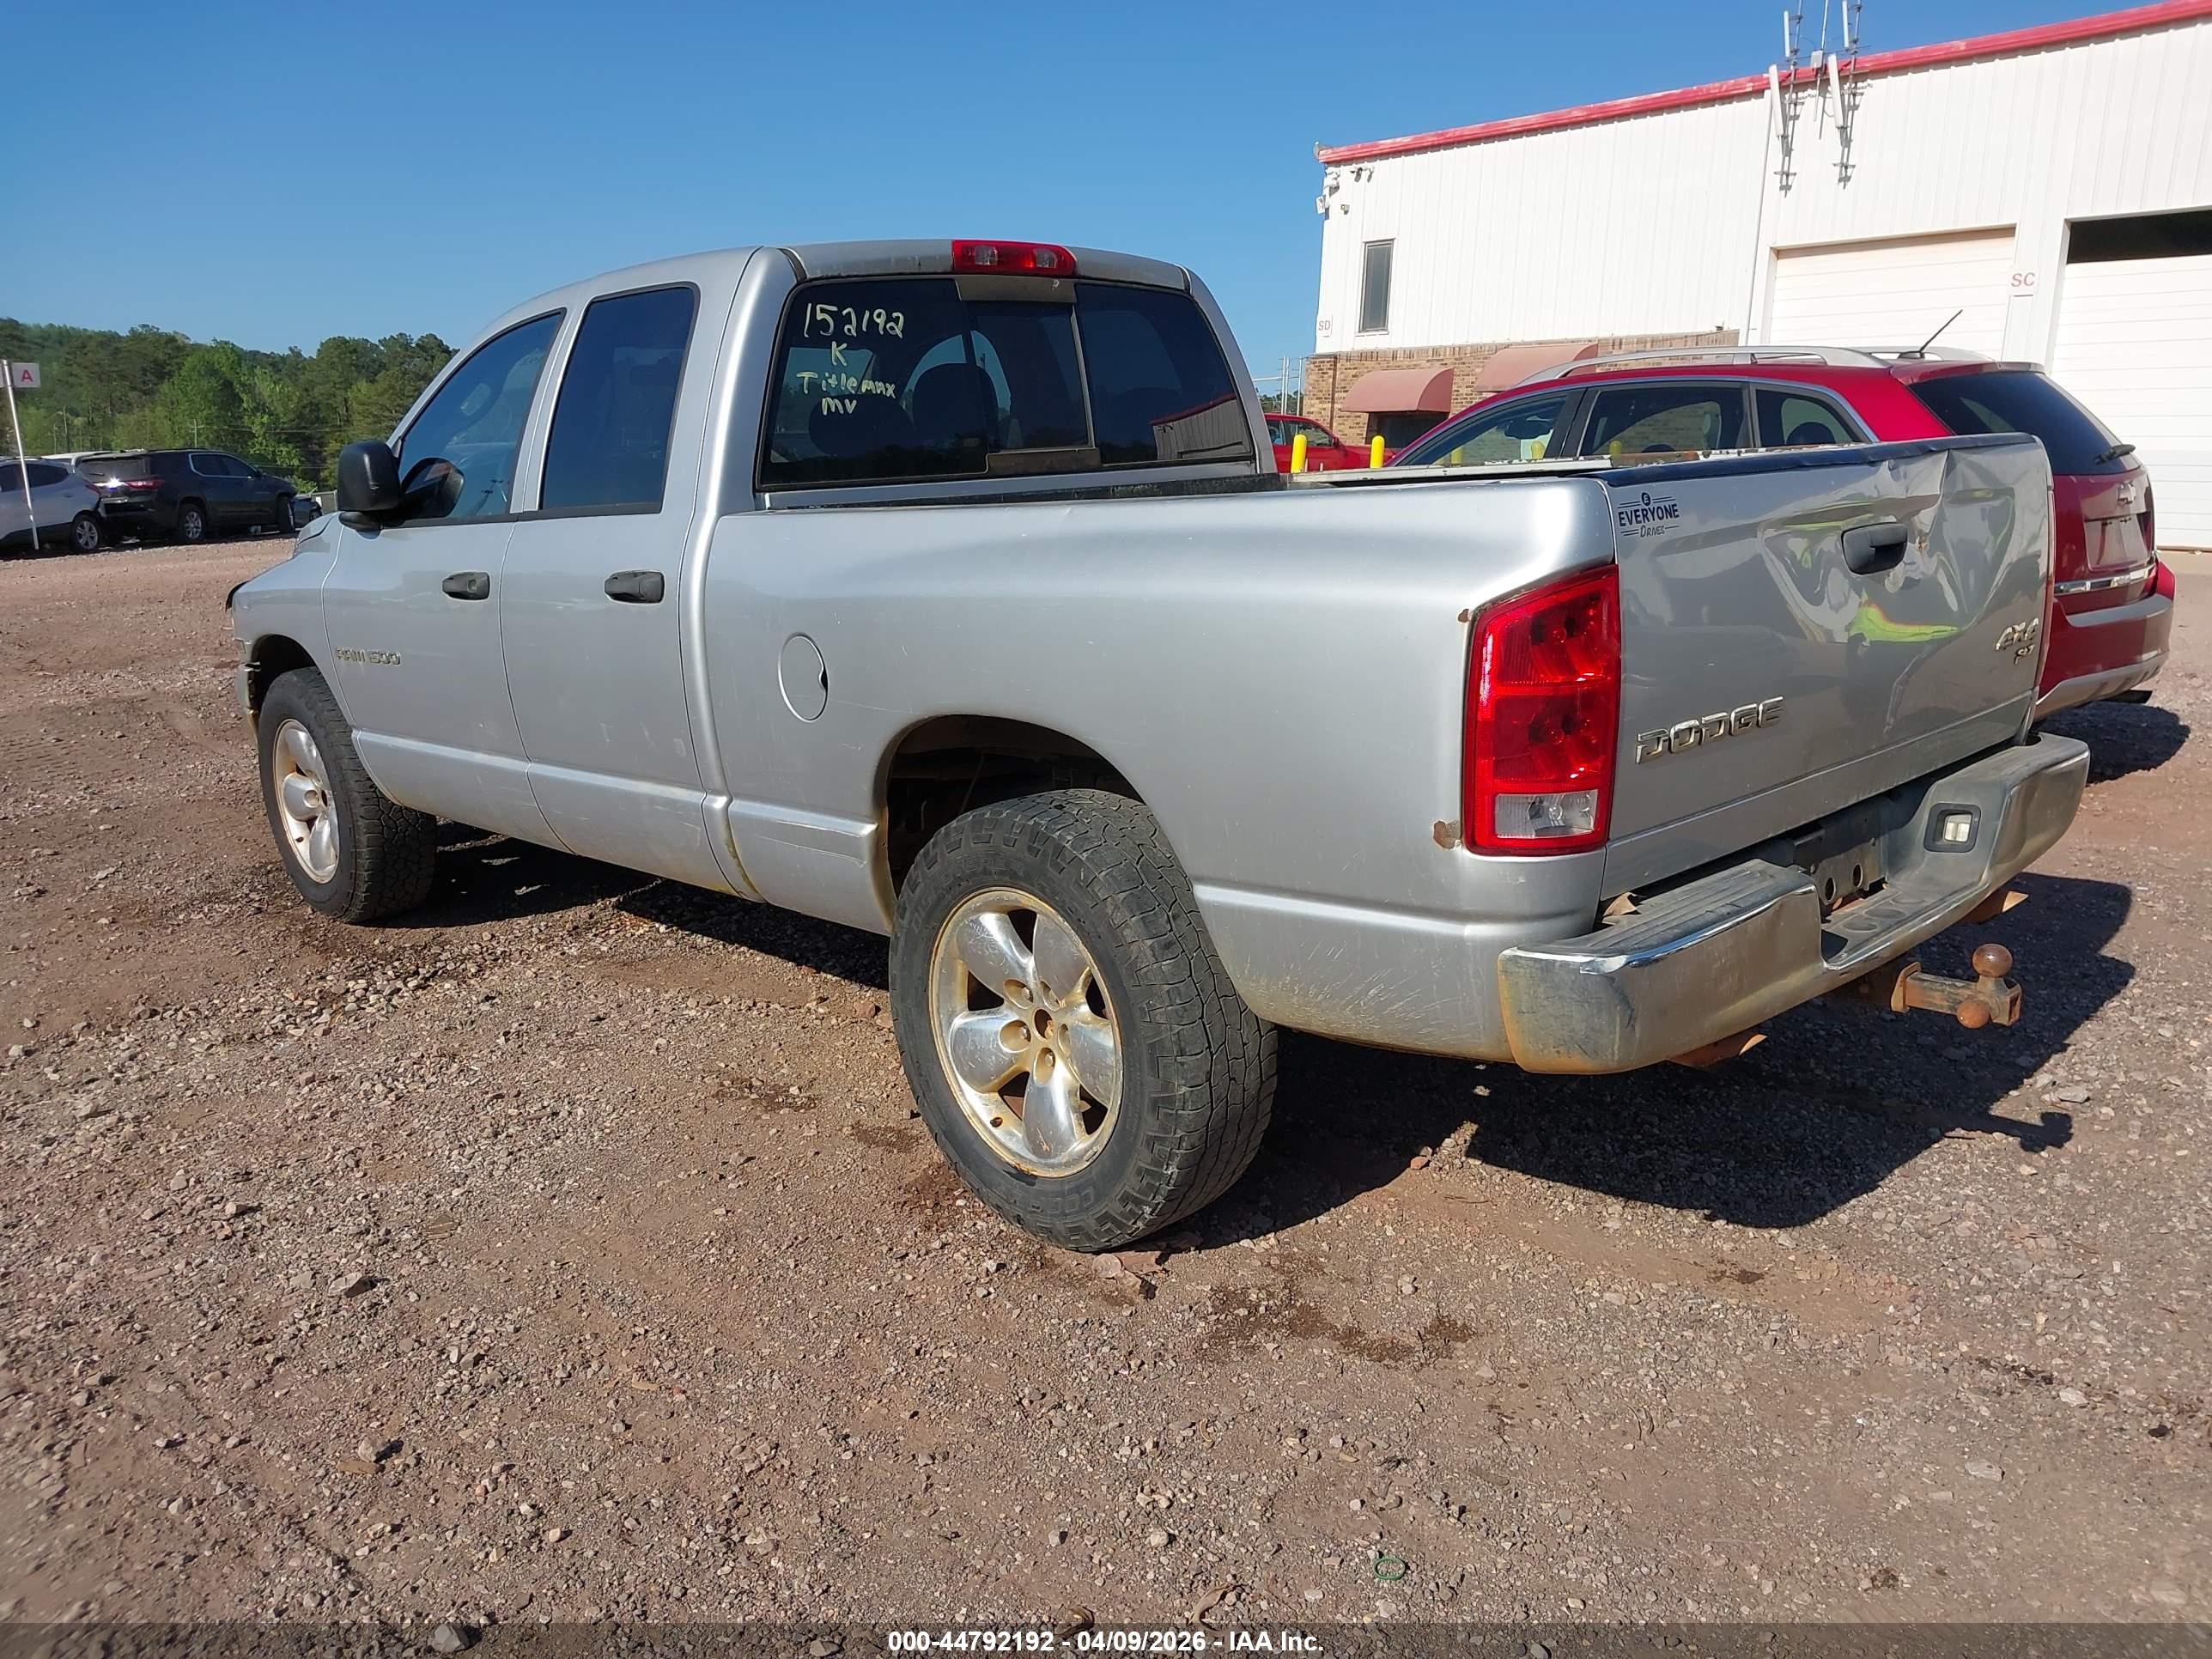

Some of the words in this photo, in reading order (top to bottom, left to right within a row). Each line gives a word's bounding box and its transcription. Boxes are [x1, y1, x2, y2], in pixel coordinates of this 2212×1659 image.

[2011, 271, 2035, 288] SC
[803, 302, 905, 338] 152192
[1318, 319, 1331, 331] SD
[831, 341, 848, 366] K
[21, 369, 34, 382] A
[1618, 503, 1680, 526] EVERYONE
[1635, 696, 1784, 764] DODGE
